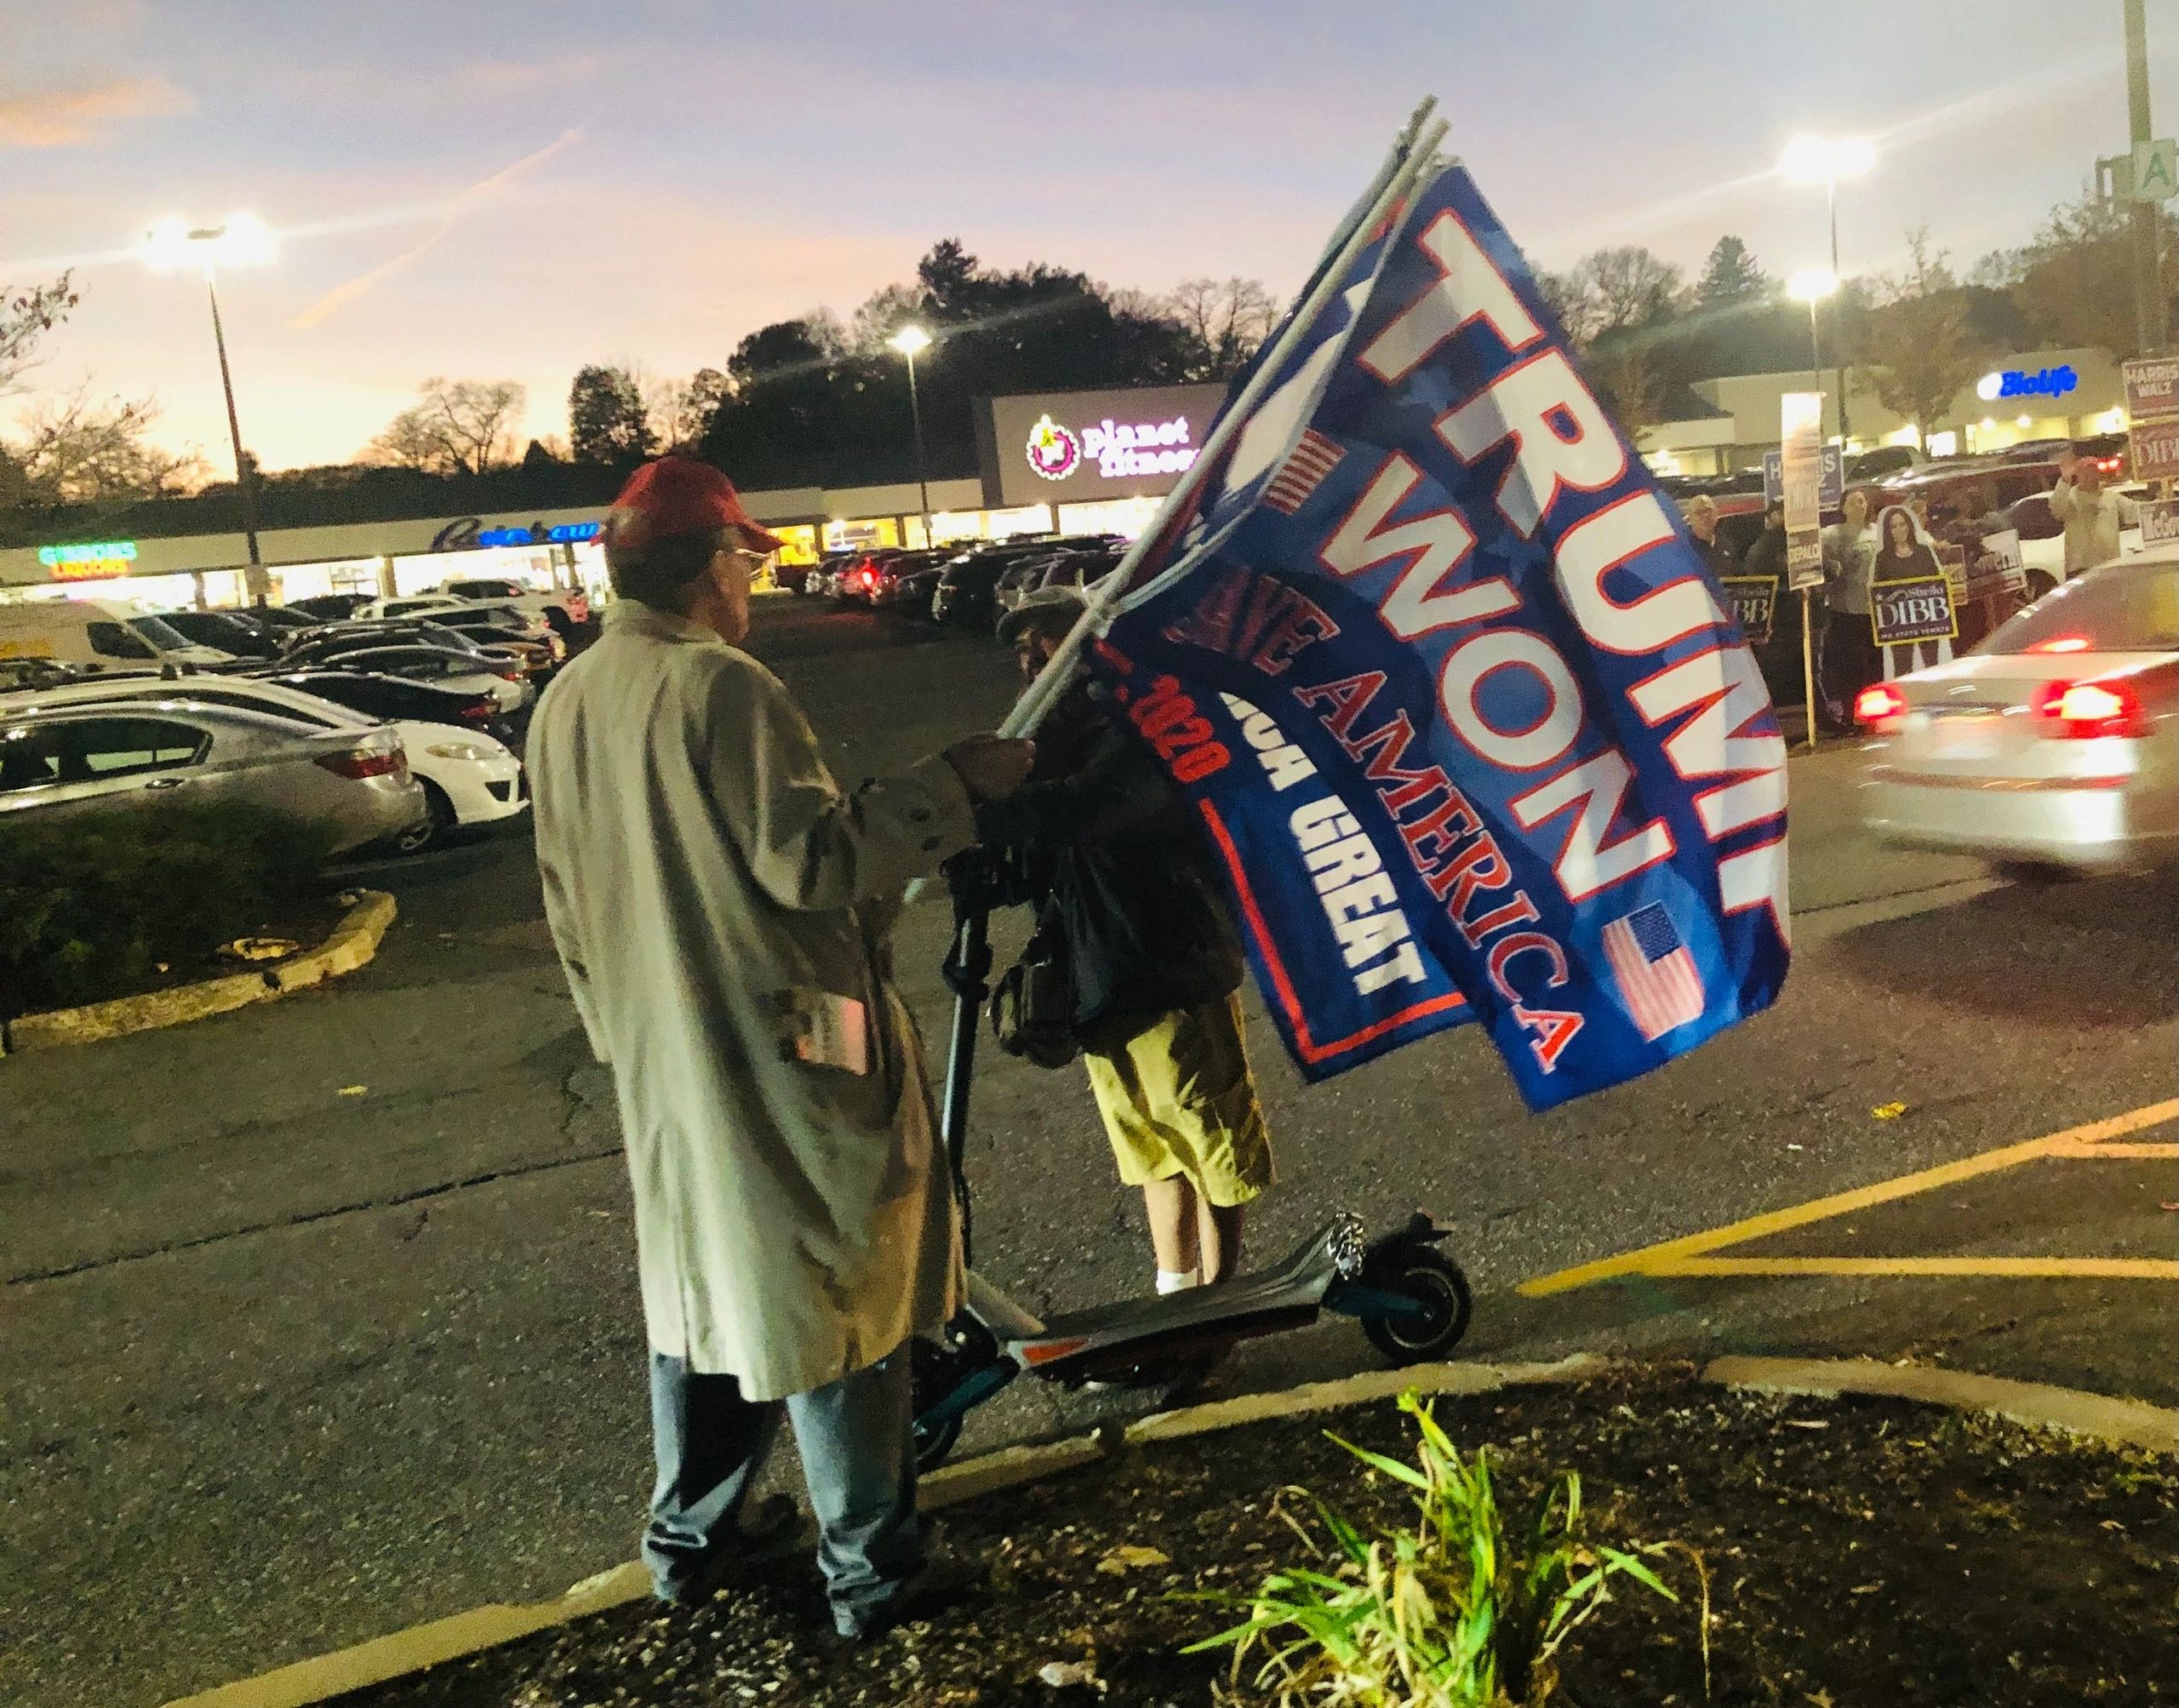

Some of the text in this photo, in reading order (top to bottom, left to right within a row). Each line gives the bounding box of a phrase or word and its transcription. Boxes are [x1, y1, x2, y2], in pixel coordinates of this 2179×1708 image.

[2143, 151, 2170, 191] A
[2000, 364, 2078, 397] BioLife
[2137, 381, 2173, 397] WALZ
[1082, 416, 1190, 459] planet
[2136, 437, 2179, 467] DIB
[1099, 448, 1201, 477] fitnes
[1875, 597, 1950, 629] DIBB
[1318, 448, 1677, 904] WON
[1292, 669, 1585, 1076] AMERICA
[1288, 793, 1428, 997] GREAT
